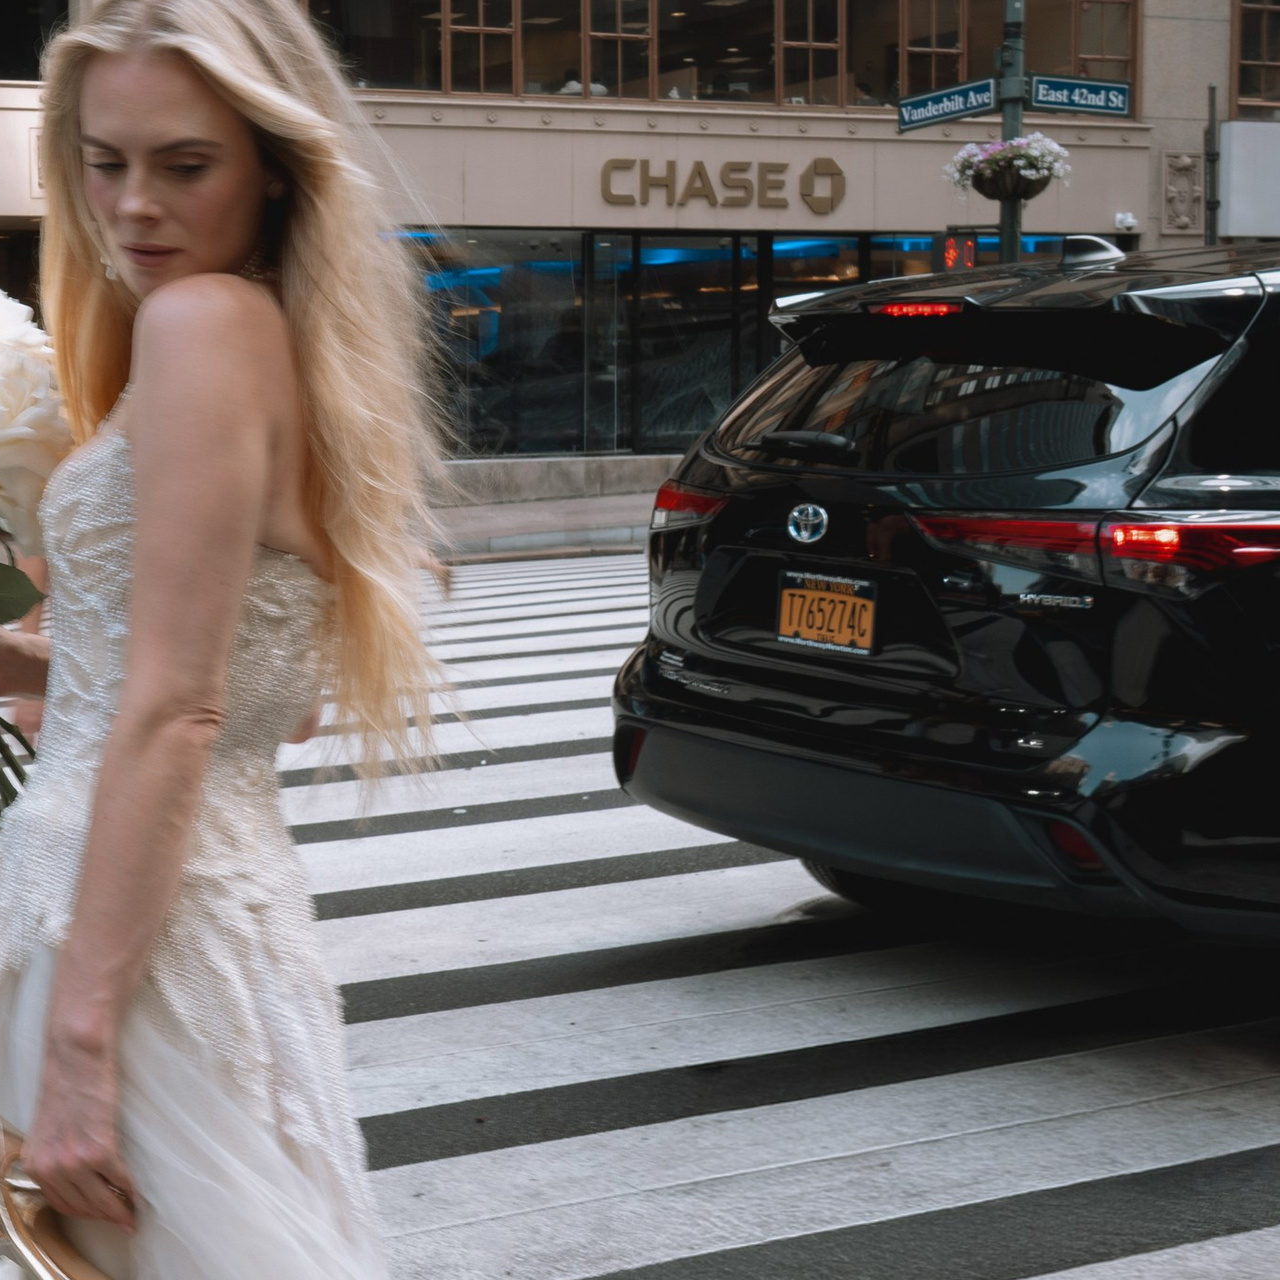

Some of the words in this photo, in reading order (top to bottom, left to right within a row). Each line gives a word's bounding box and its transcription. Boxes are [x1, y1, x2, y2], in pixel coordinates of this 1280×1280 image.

[901, 94, 965, 122] Vanderbilt
[966, 90, 991, 107] Ave
[1037, 84, 1070, 103] East
[1071, 88, 1106, 106] 42nd
[1108, 91, 1125, 108] St
[600, 158, 790, 208] CHASE
[805, 580, 827, 591] NEW
[830, 581, 856, 595] YORK
[788, 592, 868, 638] T765274C
